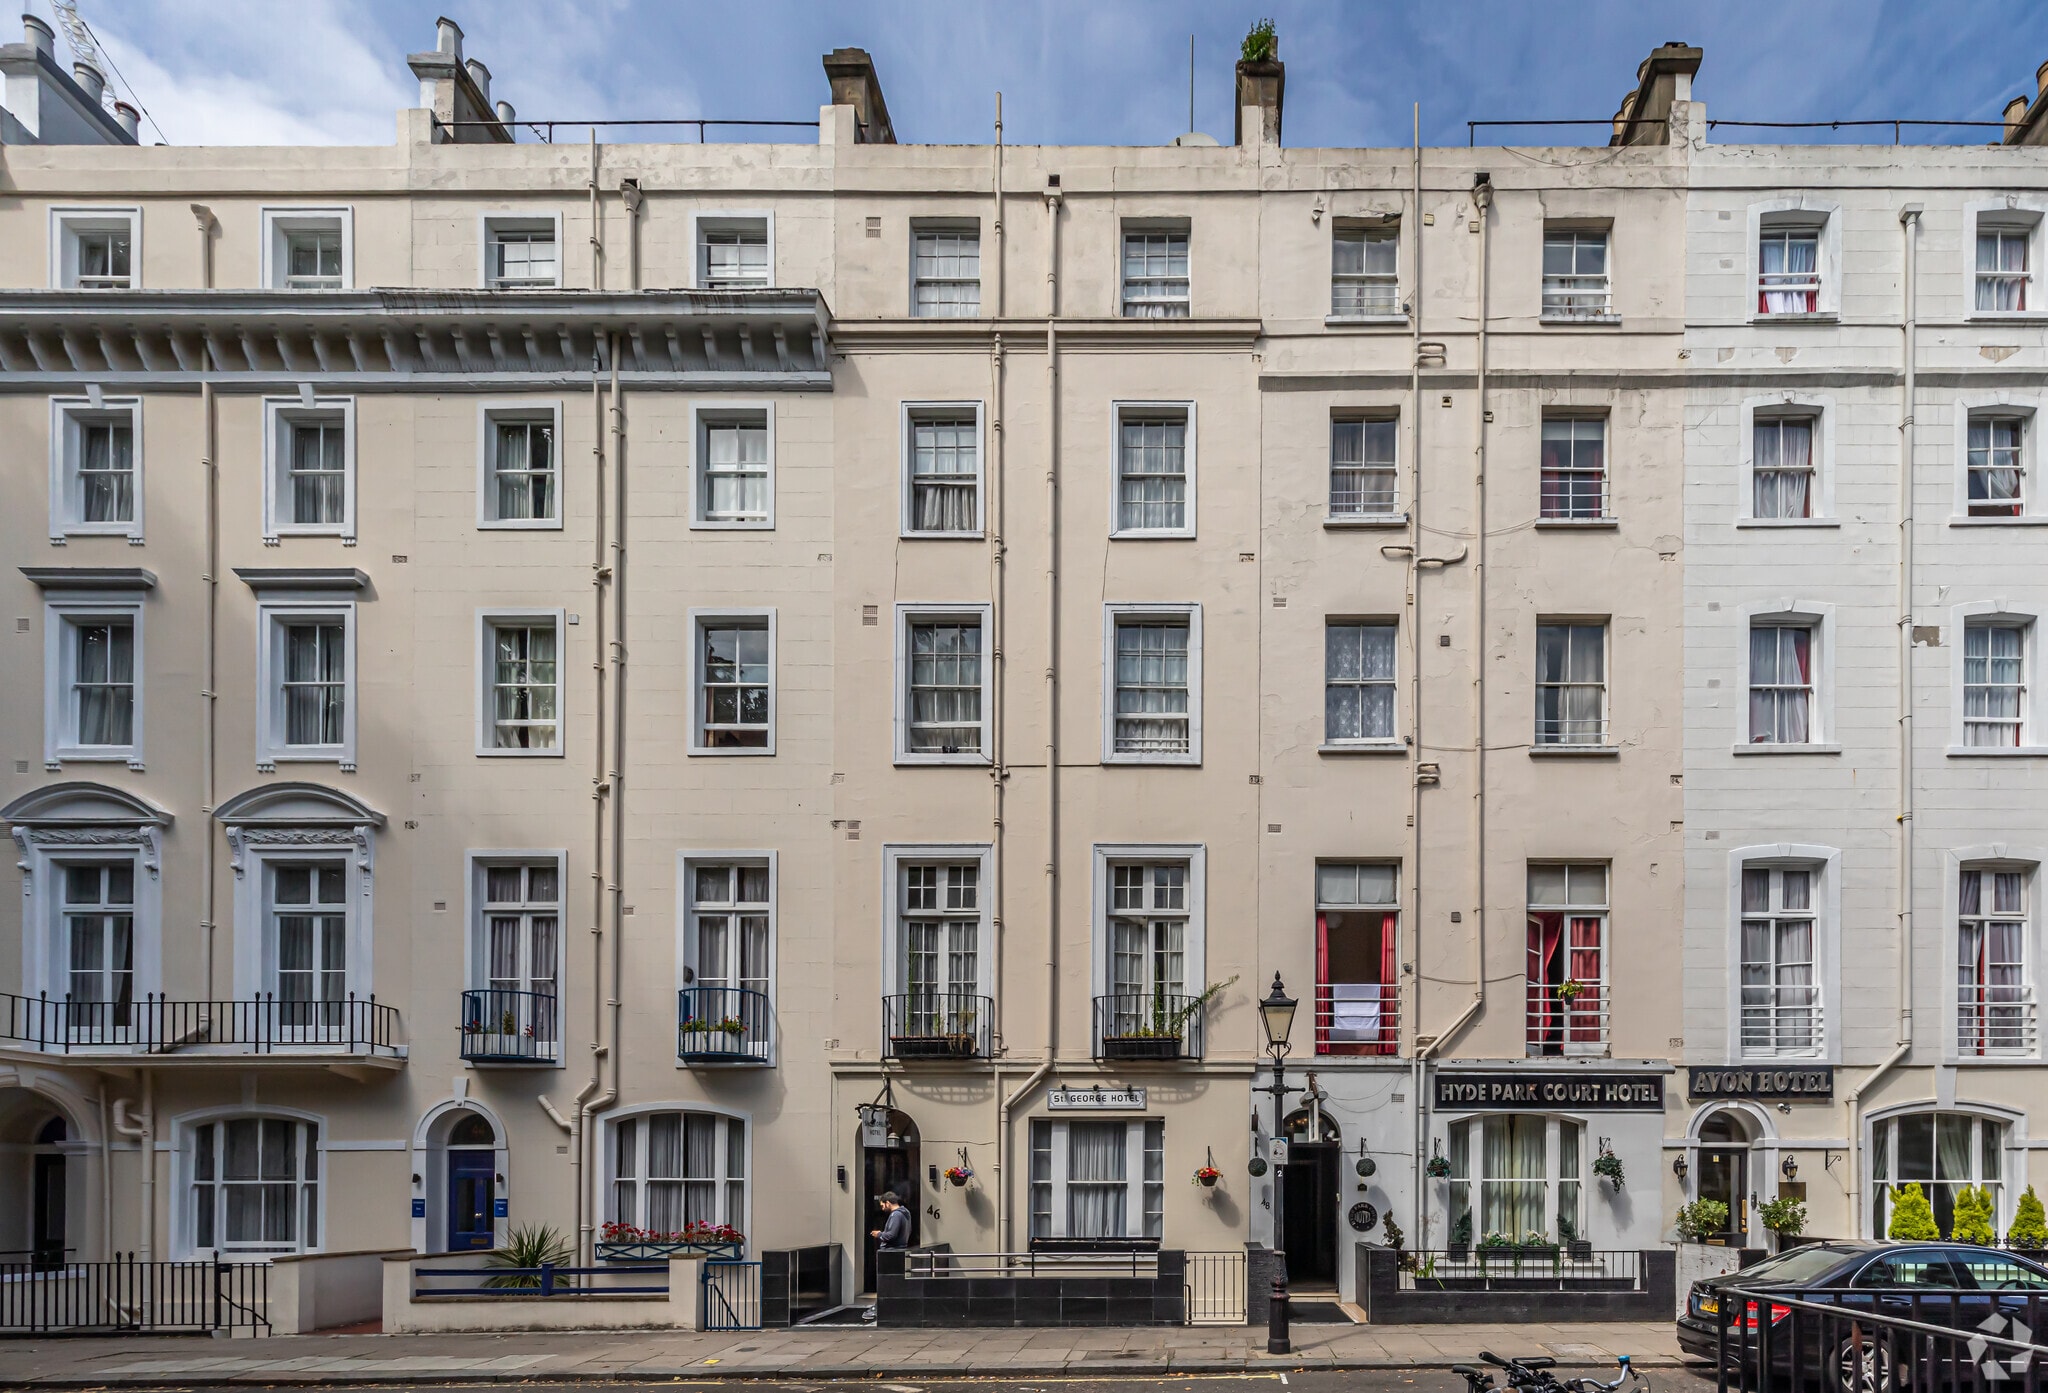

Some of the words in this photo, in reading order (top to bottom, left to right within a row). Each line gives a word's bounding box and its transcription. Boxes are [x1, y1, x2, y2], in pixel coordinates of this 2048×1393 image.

[1693, 1071, 1753, 1092] AVON
[1758, 1071, 1831, 1092] HOTEL
[1070, 1094, 1107, 1102] GEORGE
[1111, 1094, 1139, 1102] HOTEL
[1441, 1084, 1486, 1101] HYDE
[1491, 1084, 1538, 1101] PARK
[1543, 1083, 1600, 1101] COURT
[1605, 1083, 1659, 1101] HOTEL
[1276, 1169, 1283, 1177] 2
[1261, 1198, 1270, 1210] 48
[927, 1204, 940, 1220] 46
